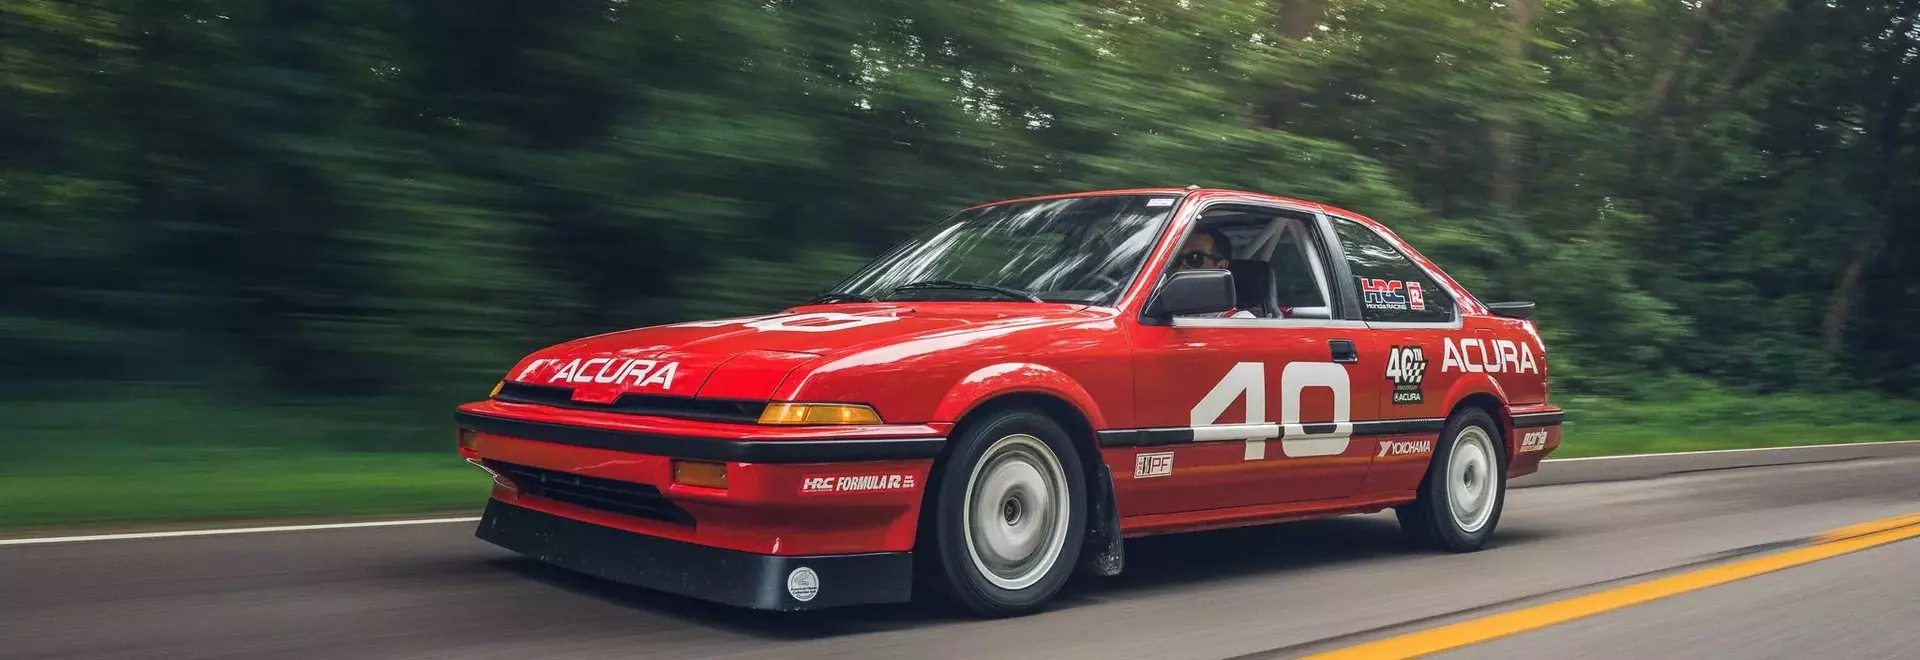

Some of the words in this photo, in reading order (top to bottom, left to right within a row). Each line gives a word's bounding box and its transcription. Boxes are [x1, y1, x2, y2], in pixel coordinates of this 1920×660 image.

[1361, 278, 1405, 304] HRC
[1441, 337, 1539, 374] ACURA
[548, 357, 680, 390] ACURA
[1399, 392, 1421, 401] ACURA
[1190, 361, 1353, 461] 40
[1391, 440, 1431, 455] YOKOHAMA
[803, 477, 835, 490] HRC
[835, 475, 888, 491] FORMULA
